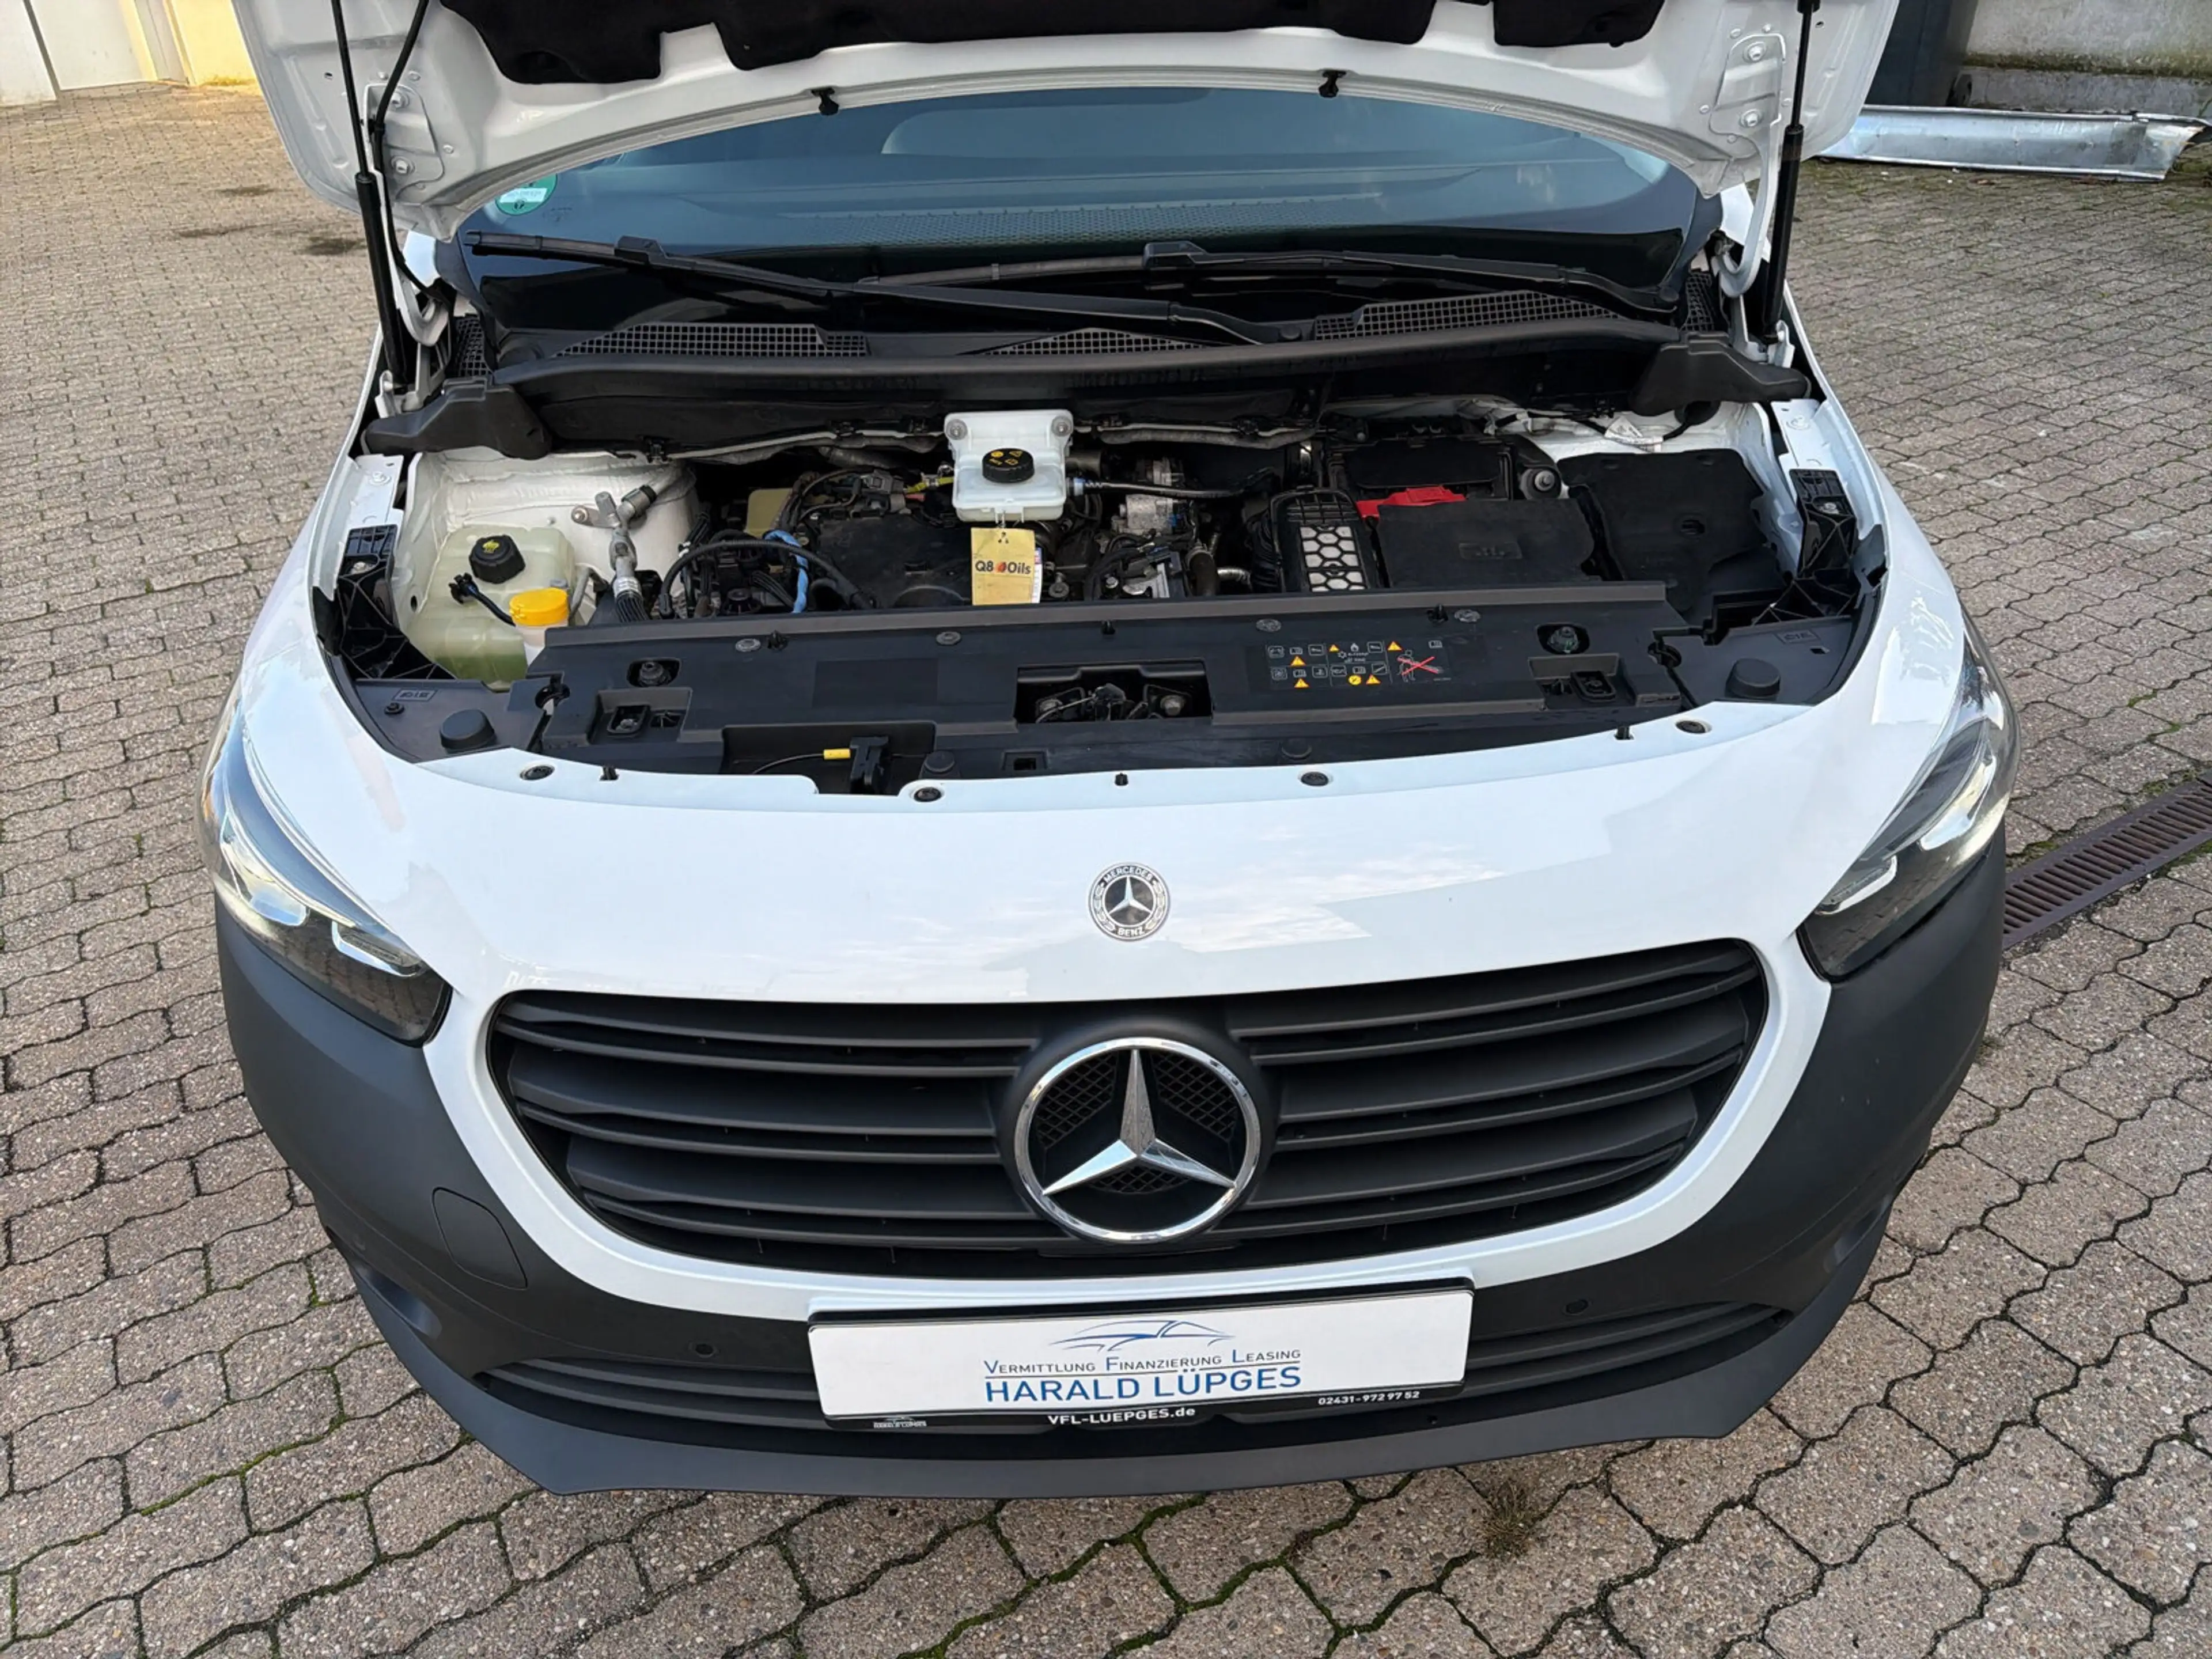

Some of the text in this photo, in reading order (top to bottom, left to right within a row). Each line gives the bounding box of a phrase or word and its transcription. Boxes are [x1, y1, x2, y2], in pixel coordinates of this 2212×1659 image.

[975, 560, 1031, 574] Q8 Oils
[1103, 866, 1153, 882] MERCEDES
[1118, 927, 1145, 936] BENZ
[984, 1349, 1301, 1373] VERMITTLUNG FINANZIERUNG LEASING
[986, 1366, 1301, 1402] HARALD LÜPGES
[1318, 1391, 1420, 1405] 02431-972 97 52
[1048, 1407, 1195, 1425] VFL-LUEPGES.de
